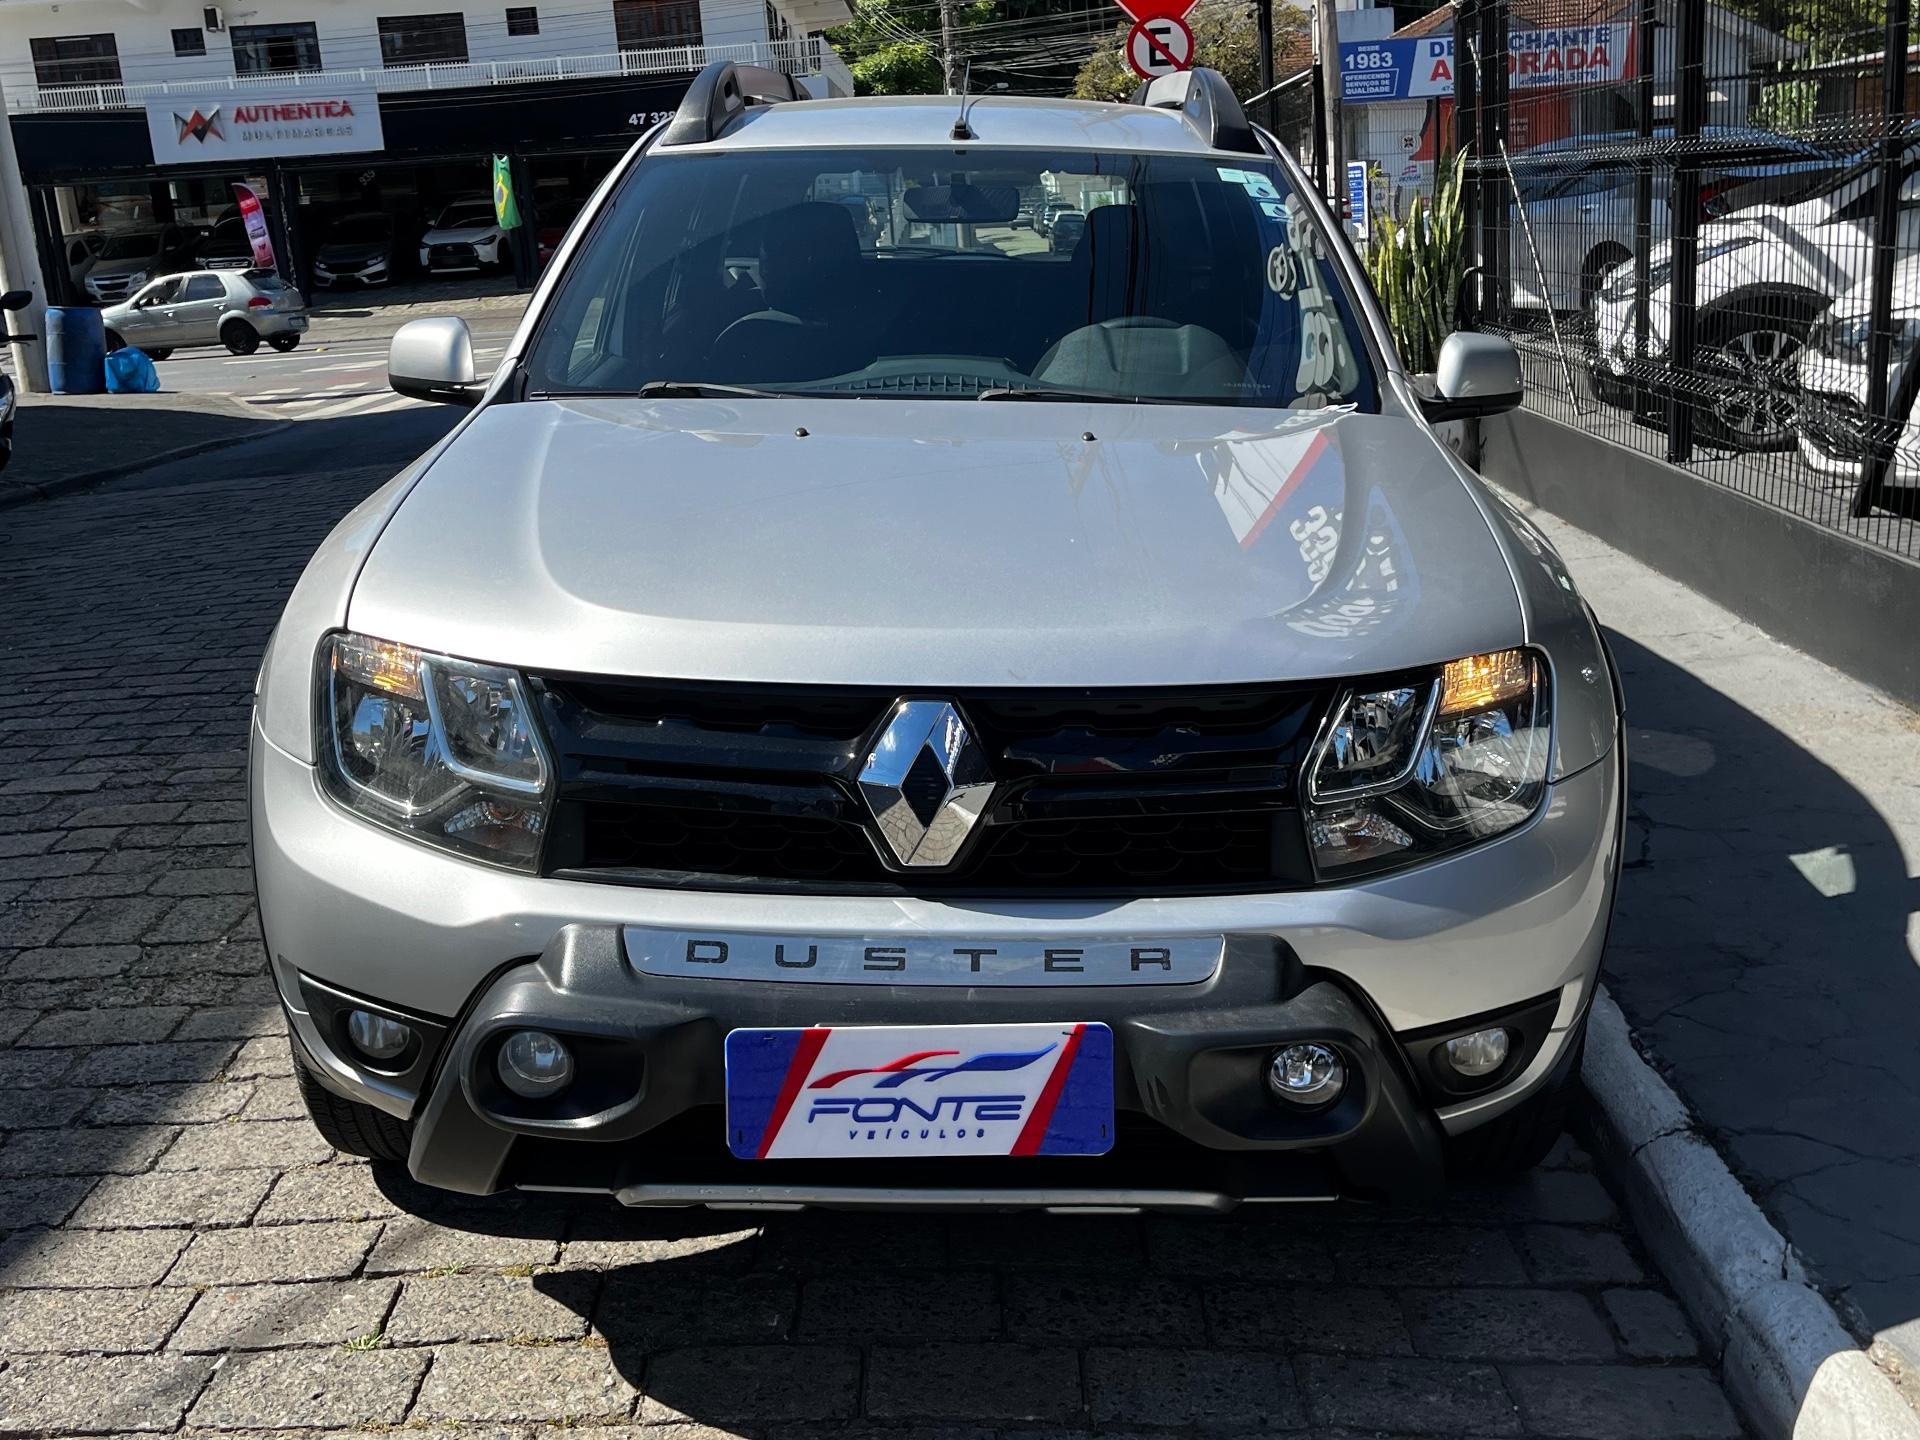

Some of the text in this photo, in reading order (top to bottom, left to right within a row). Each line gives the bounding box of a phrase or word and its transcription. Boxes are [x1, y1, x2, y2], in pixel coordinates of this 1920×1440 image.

[1149, 27, 1172, 67] E
[1345, 52, 1393, 70] 1983
[1345, 72, 1391, 81] OFERECENDO
[1345, 80, 1380, 88] SERVIÇOS
[1345, 85, 1391, 95] QUALIDADE
[234, 100, 355, 124] AUTHENTICA
[628, 113, 646, 125] 47
[242, 126, 353, 142] MULTIMARCAS
[685, 939, 1172, 972] DUSTER
[807, 1095, 1026, 1124] FONTE
